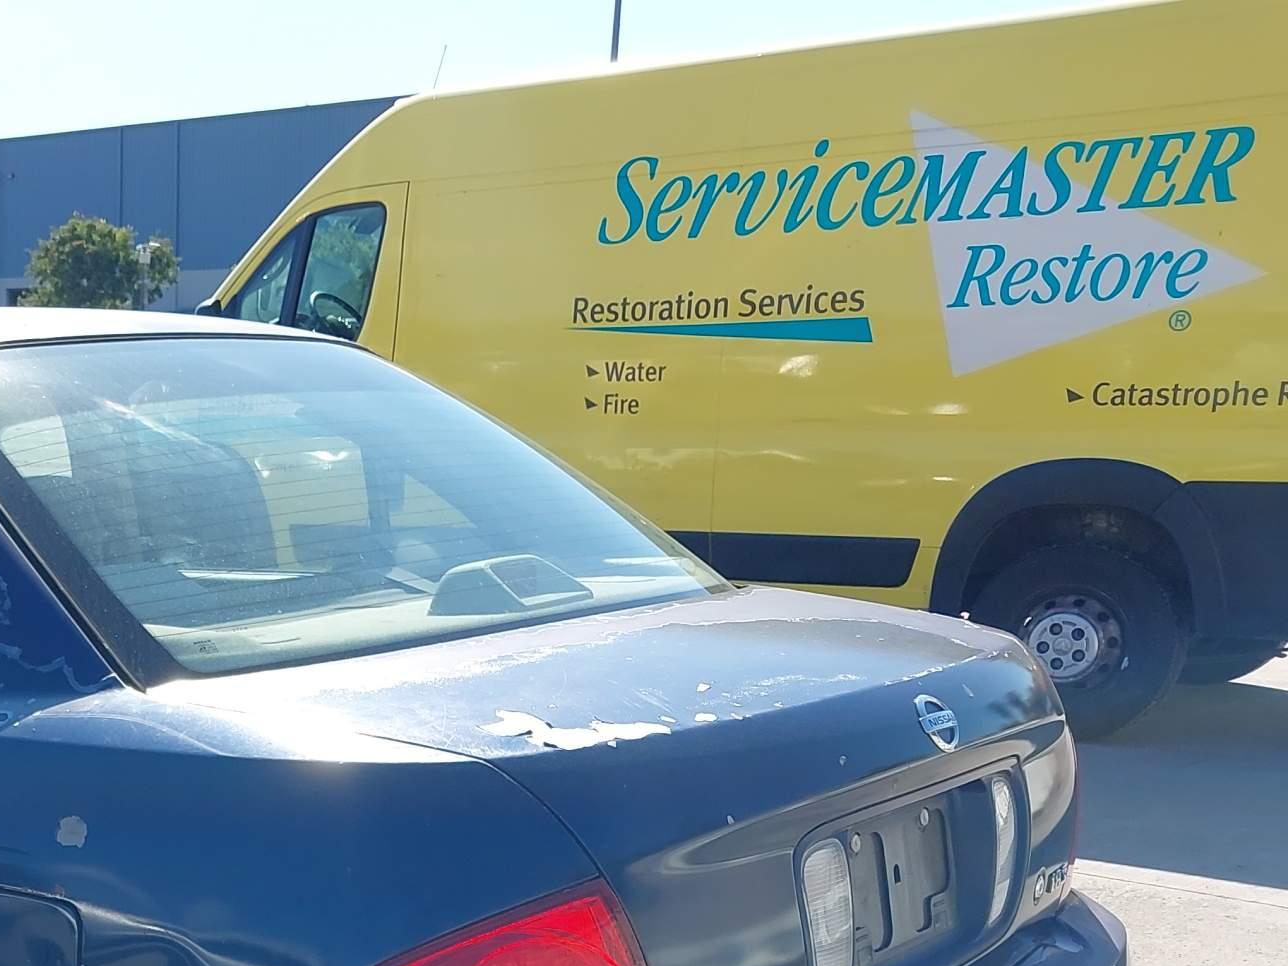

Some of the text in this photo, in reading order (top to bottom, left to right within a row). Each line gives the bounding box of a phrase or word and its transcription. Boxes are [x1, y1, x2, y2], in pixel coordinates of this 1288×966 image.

[598, 125, 1256, 245] ServiceMASTER
[946, 242, 1210, 311] Restore
[572, 284, 866, 324] Restoration Services
[605, 361, 667, 382] Water
[603, 393, 640, 415] Fire
[1092, 380, 1269, 413] Catastrophe
